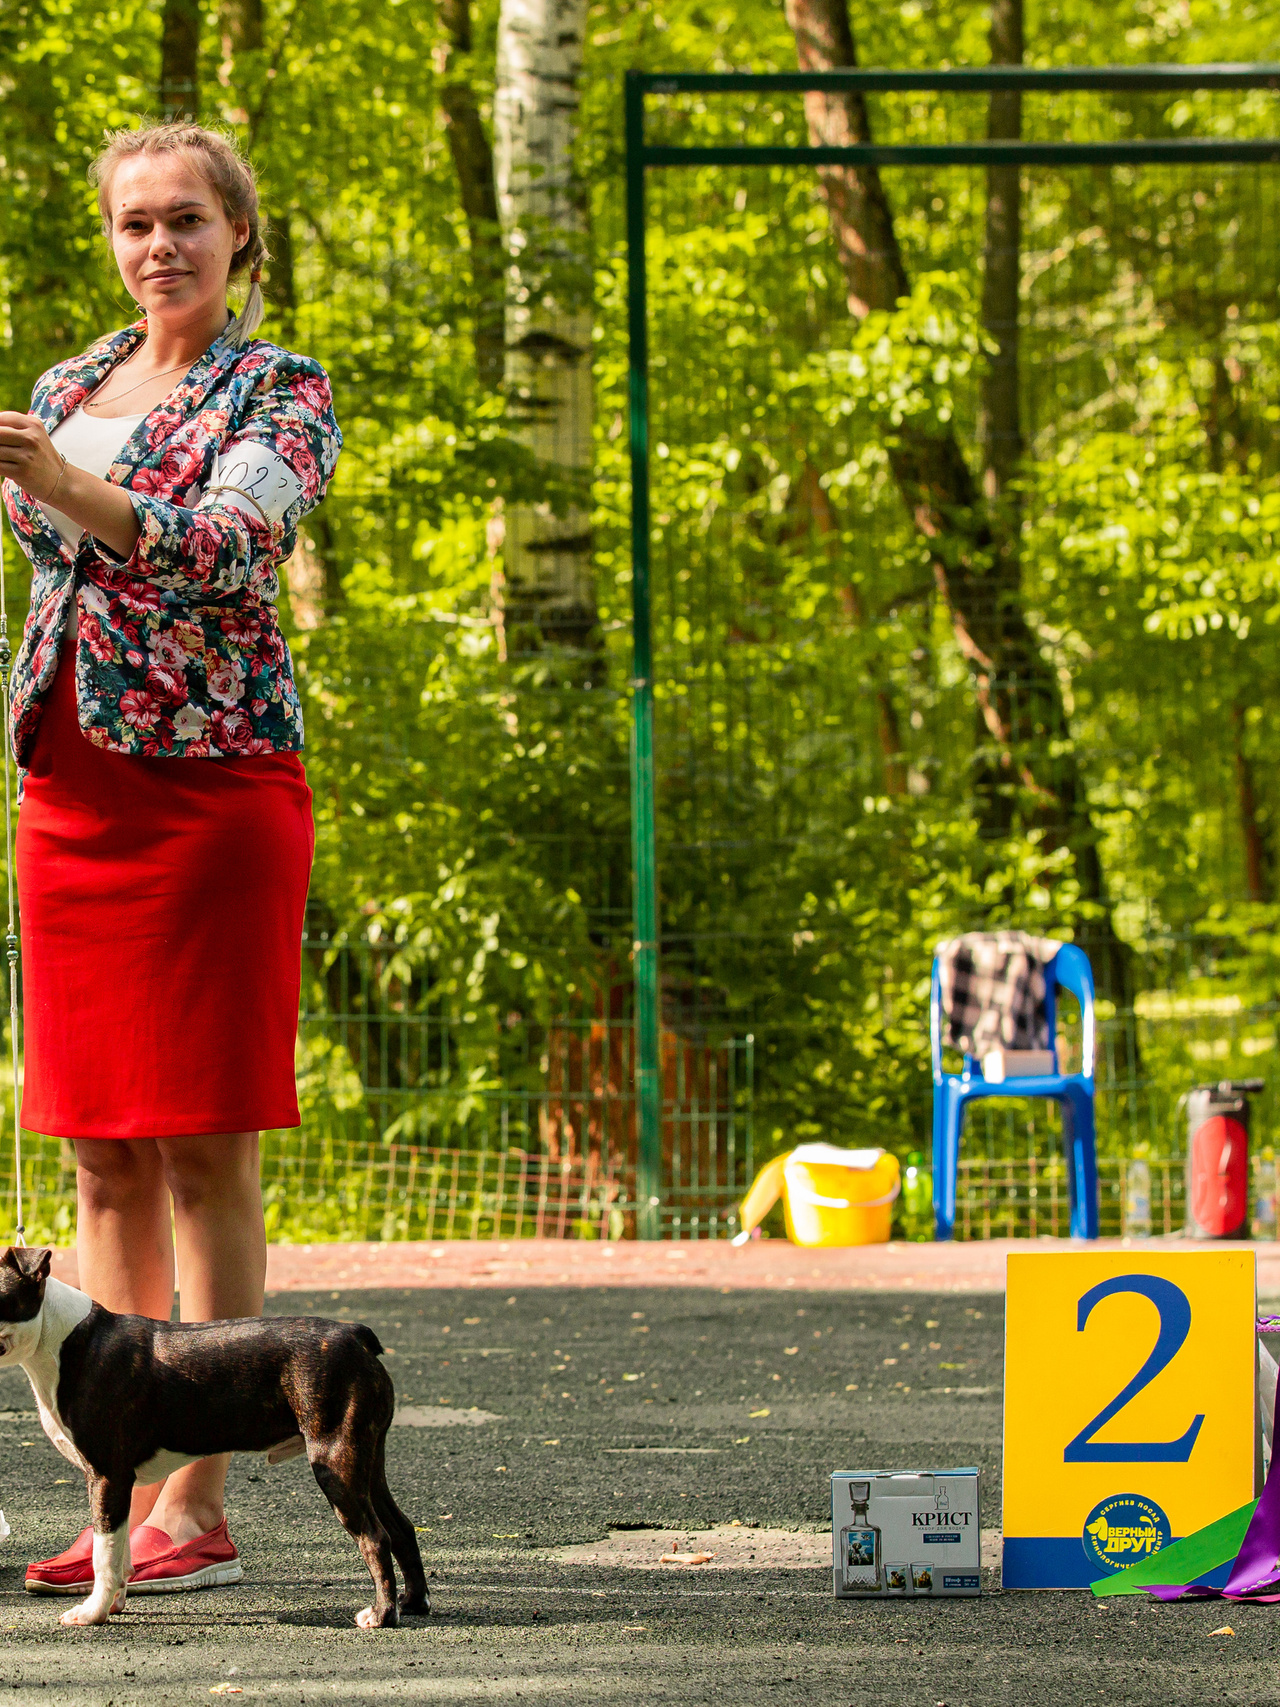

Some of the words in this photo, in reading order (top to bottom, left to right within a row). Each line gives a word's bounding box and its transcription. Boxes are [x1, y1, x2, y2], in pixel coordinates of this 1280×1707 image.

[1063, 1273, 1206, 1463] 2
[911, 1512, 973, 1526] КРИСТ
[1100, 1499, 1135, 1515] СЕРГИЕВ
[1137, 1502, 1161, 1523] ПОСАД
[1107, 1527, 1156, 1537] ВЕРНЫЙ
[1104, 1537, 1156, 1553] ДРУГ
